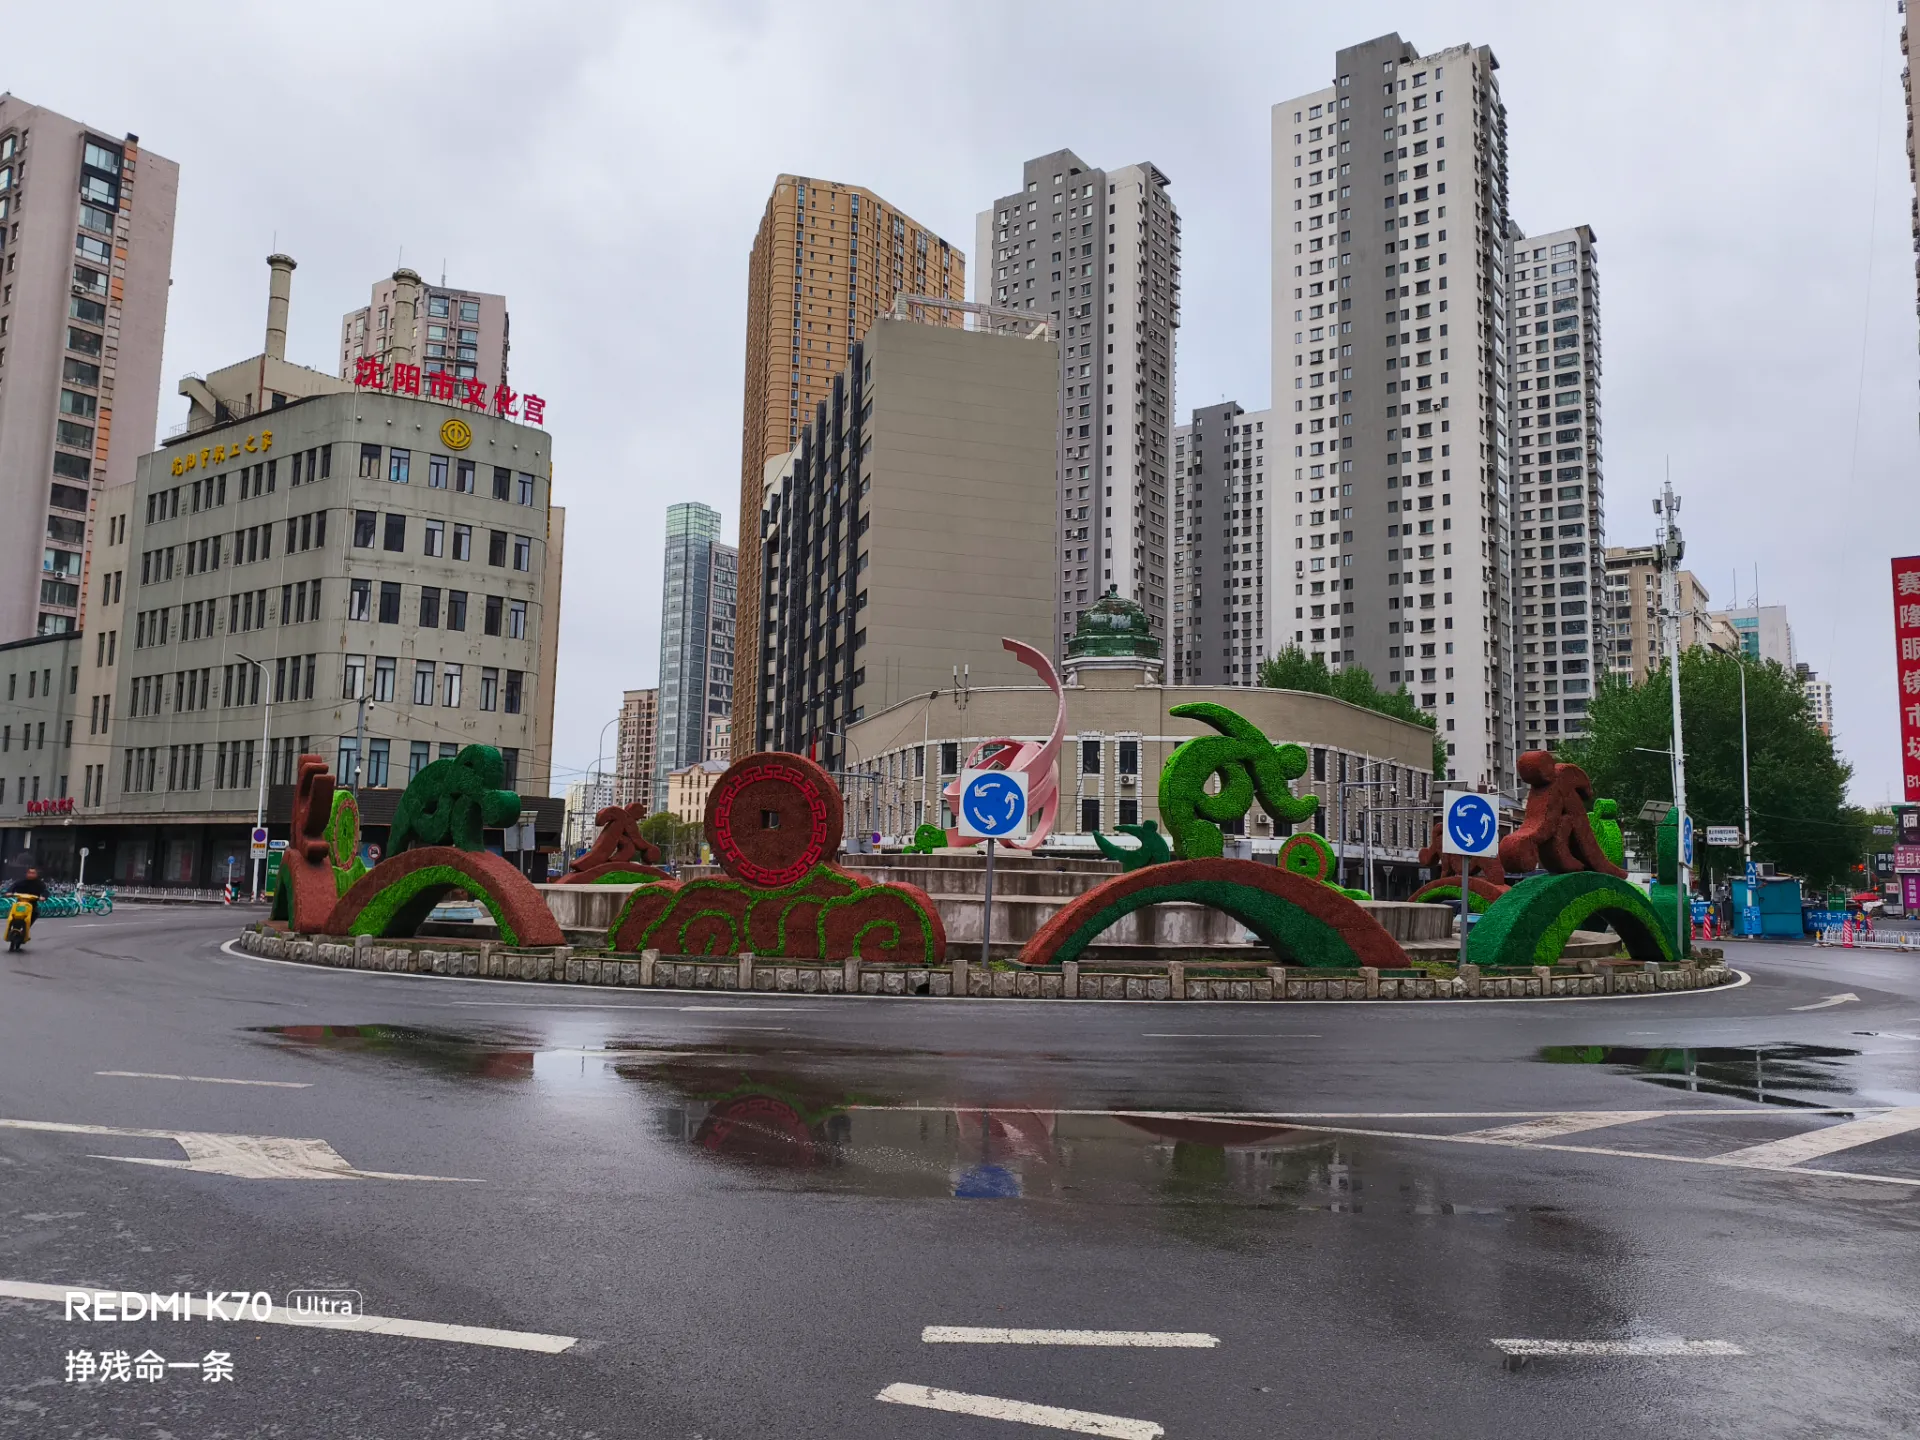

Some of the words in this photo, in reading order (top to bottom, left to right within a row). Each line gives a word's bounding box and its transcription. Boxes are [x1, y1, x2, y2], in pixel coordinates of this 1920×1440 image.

[354, 356, 546, 425] 沈阳市文化宫
[172, 430, 273, 476] 沈阳市职工之家
[1747, 863, 1756, 885] 入口
